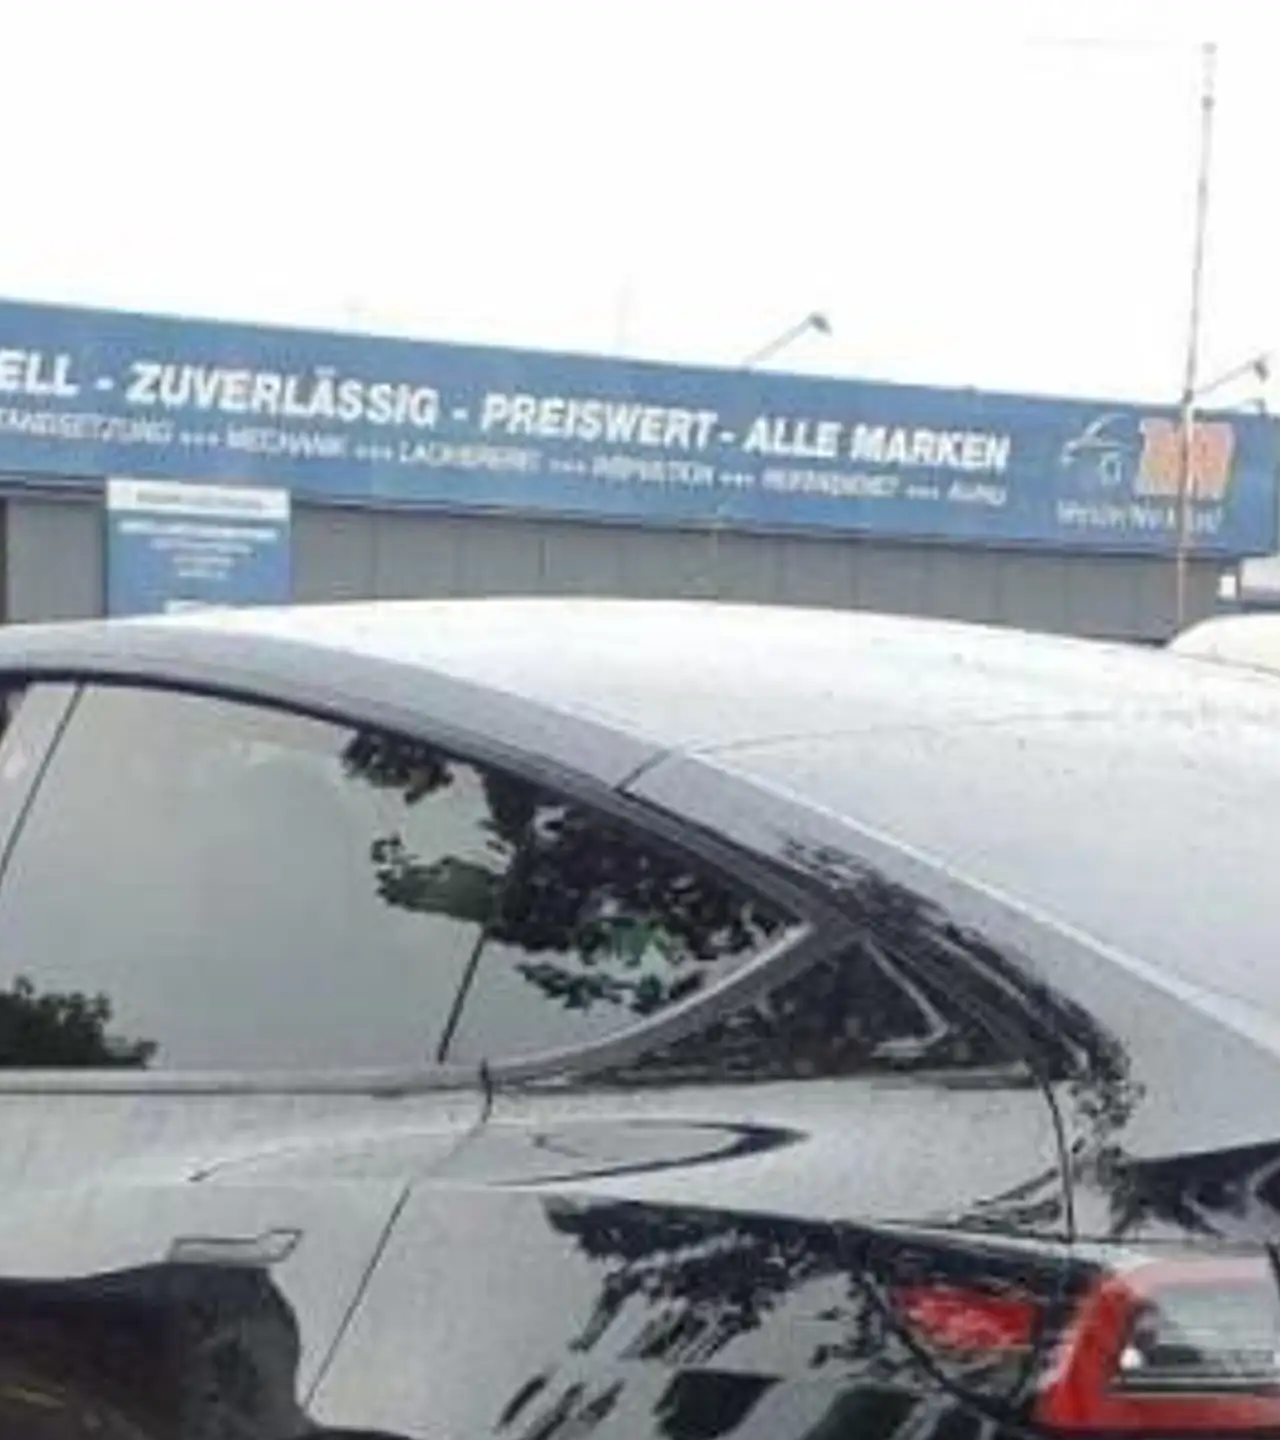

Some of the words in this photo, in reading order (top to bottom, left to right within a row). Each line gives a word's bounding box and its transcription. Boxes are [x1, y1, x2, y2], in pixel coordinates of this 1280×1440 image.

[126, 360, 439, 427] ZUVERLÄSSIG
[480, 392, 718, 450] PREISWERT
[741, 416, 842, 459] ALLE
[851, 422, 1011, 475] MARKEN
